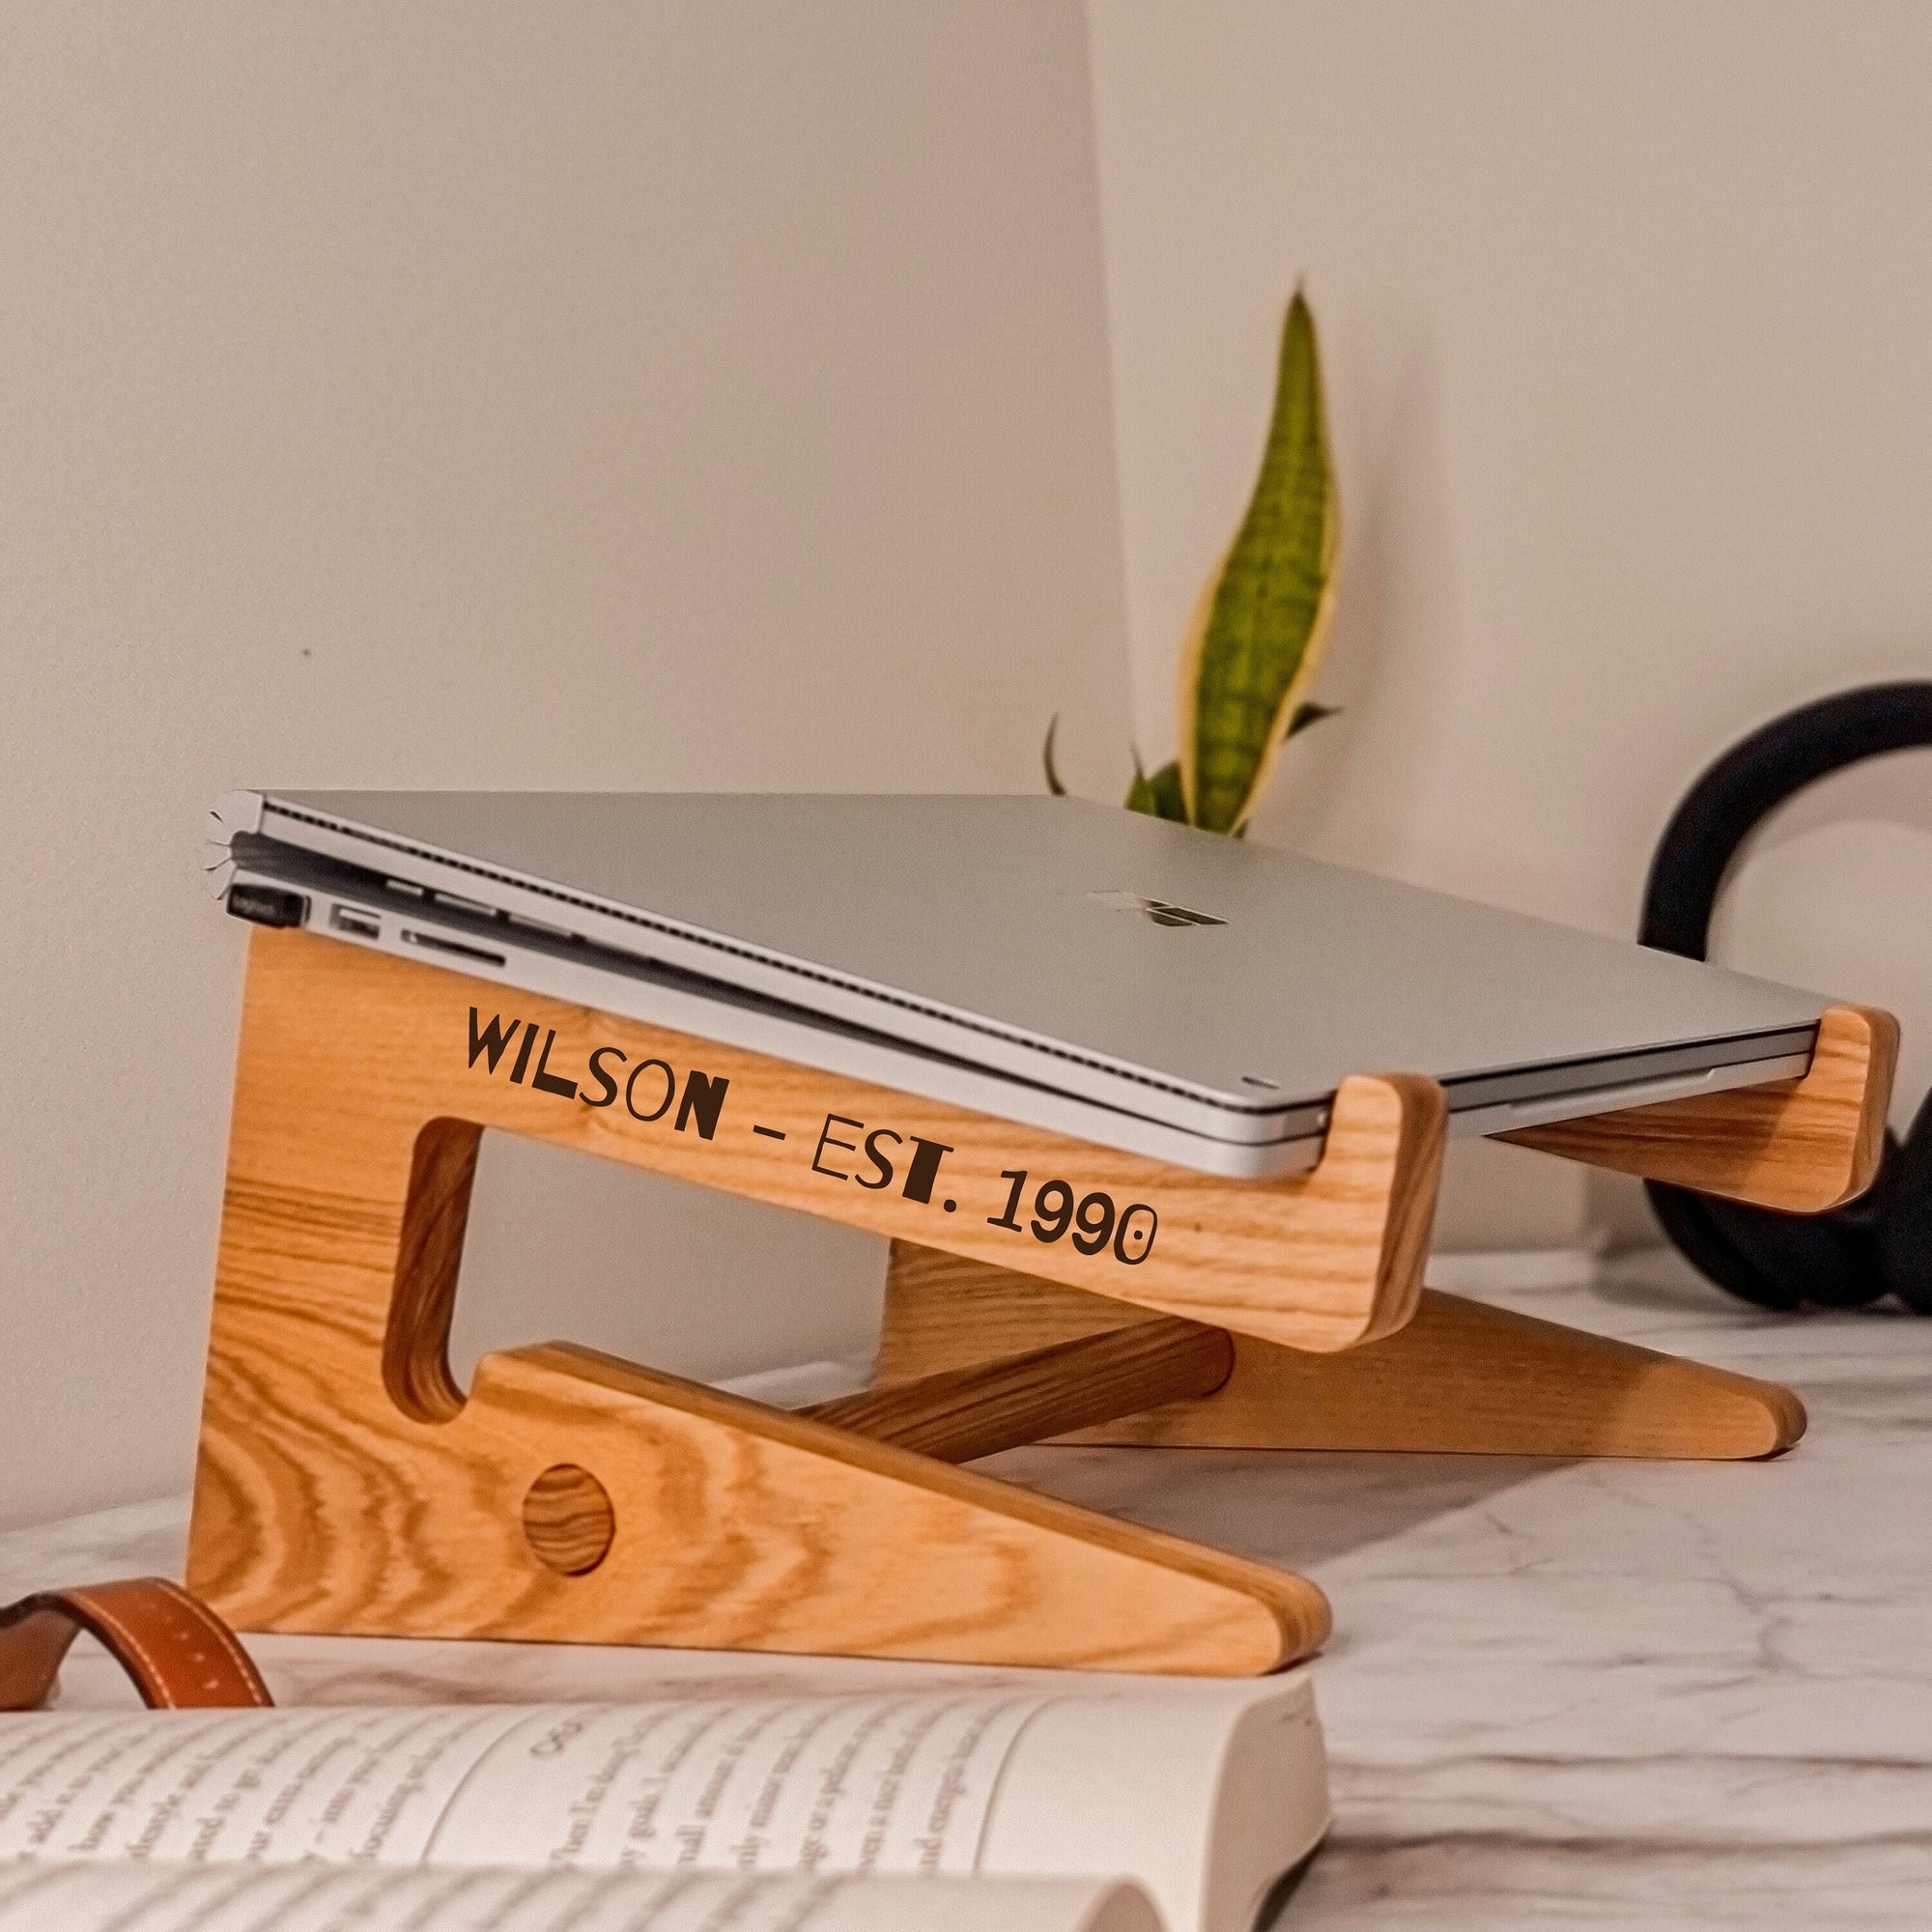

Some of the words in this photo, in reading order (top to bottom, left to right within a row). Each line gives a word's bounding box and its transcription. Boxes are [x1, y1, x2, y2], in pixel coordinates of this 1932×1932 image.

[468, 1006, 730, 1141] WILSON
[811, 1113, 957, 1213] EST.
[986, 1170, 1158, 1265] 1990
